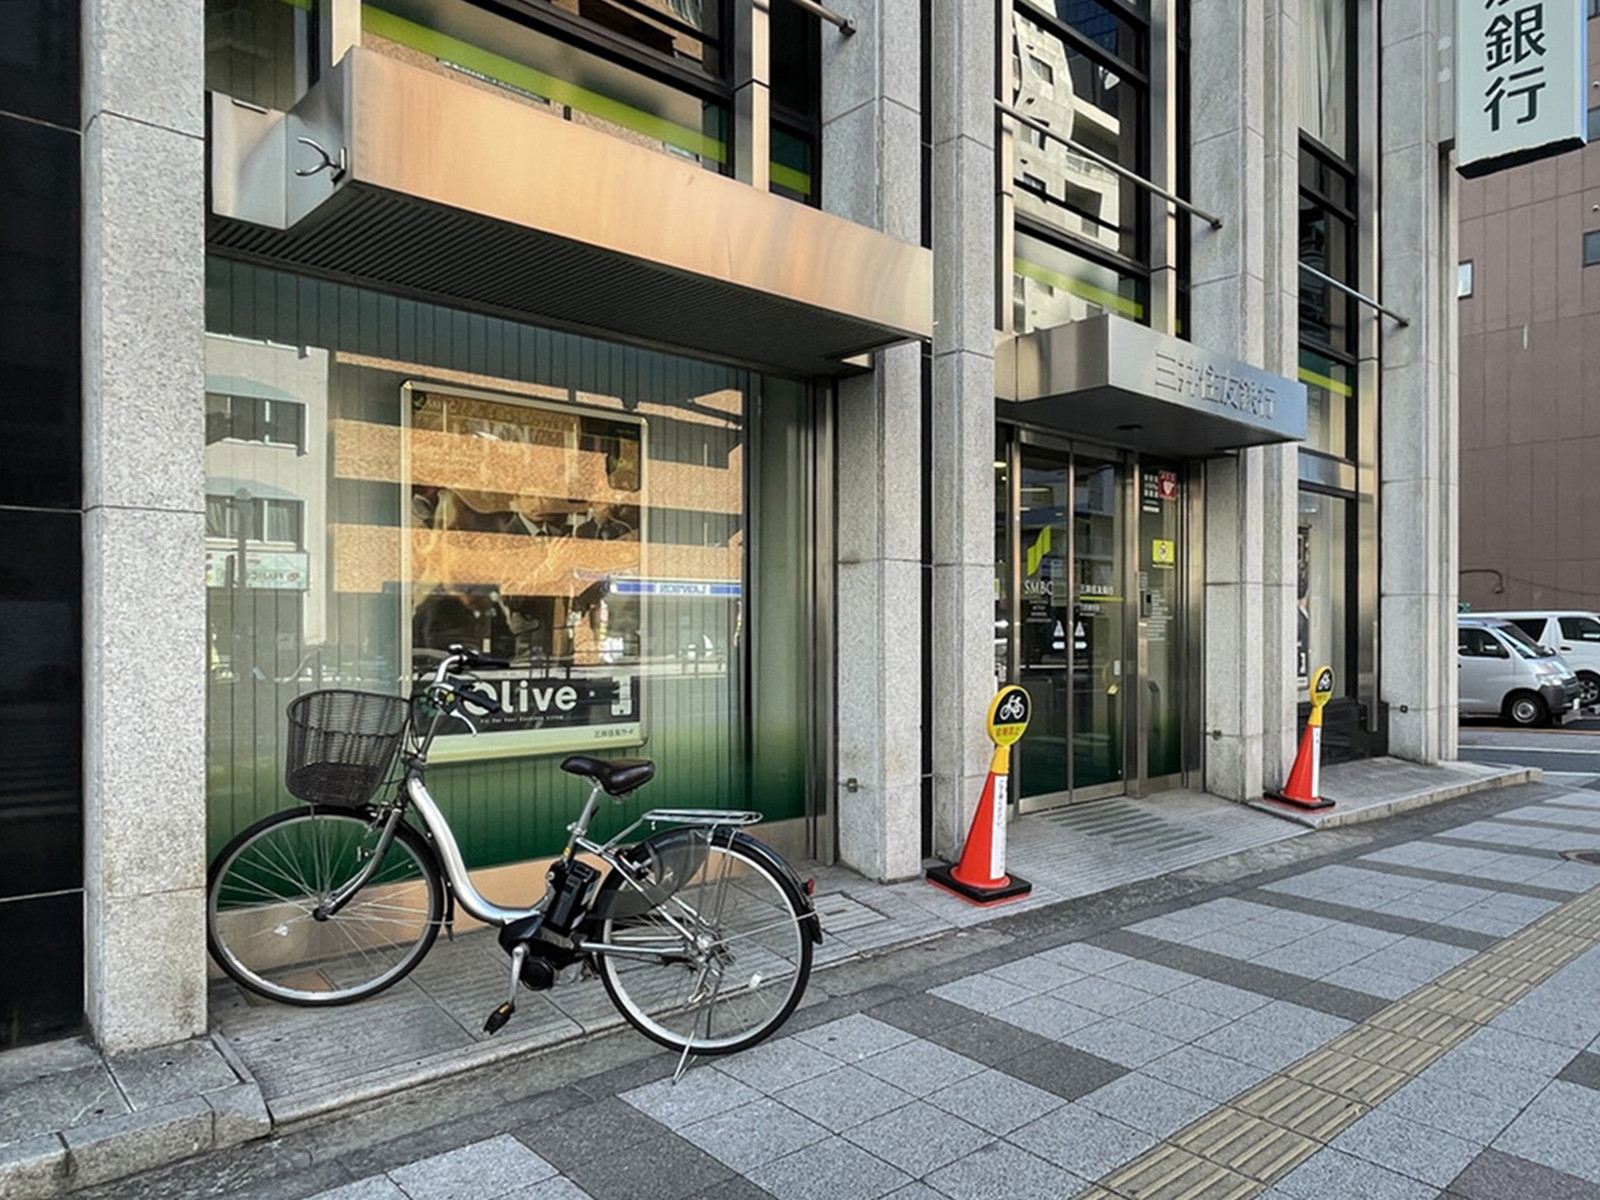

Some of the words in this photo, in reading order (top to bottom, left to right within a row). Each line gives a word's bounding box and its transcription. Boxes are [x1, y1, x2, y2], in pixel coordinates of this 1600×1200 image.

[1484, 0, 1547, 132] 銀行
[1024, 579, 1054, 596] SMBC
[463, 680, 577, 716] Olive
